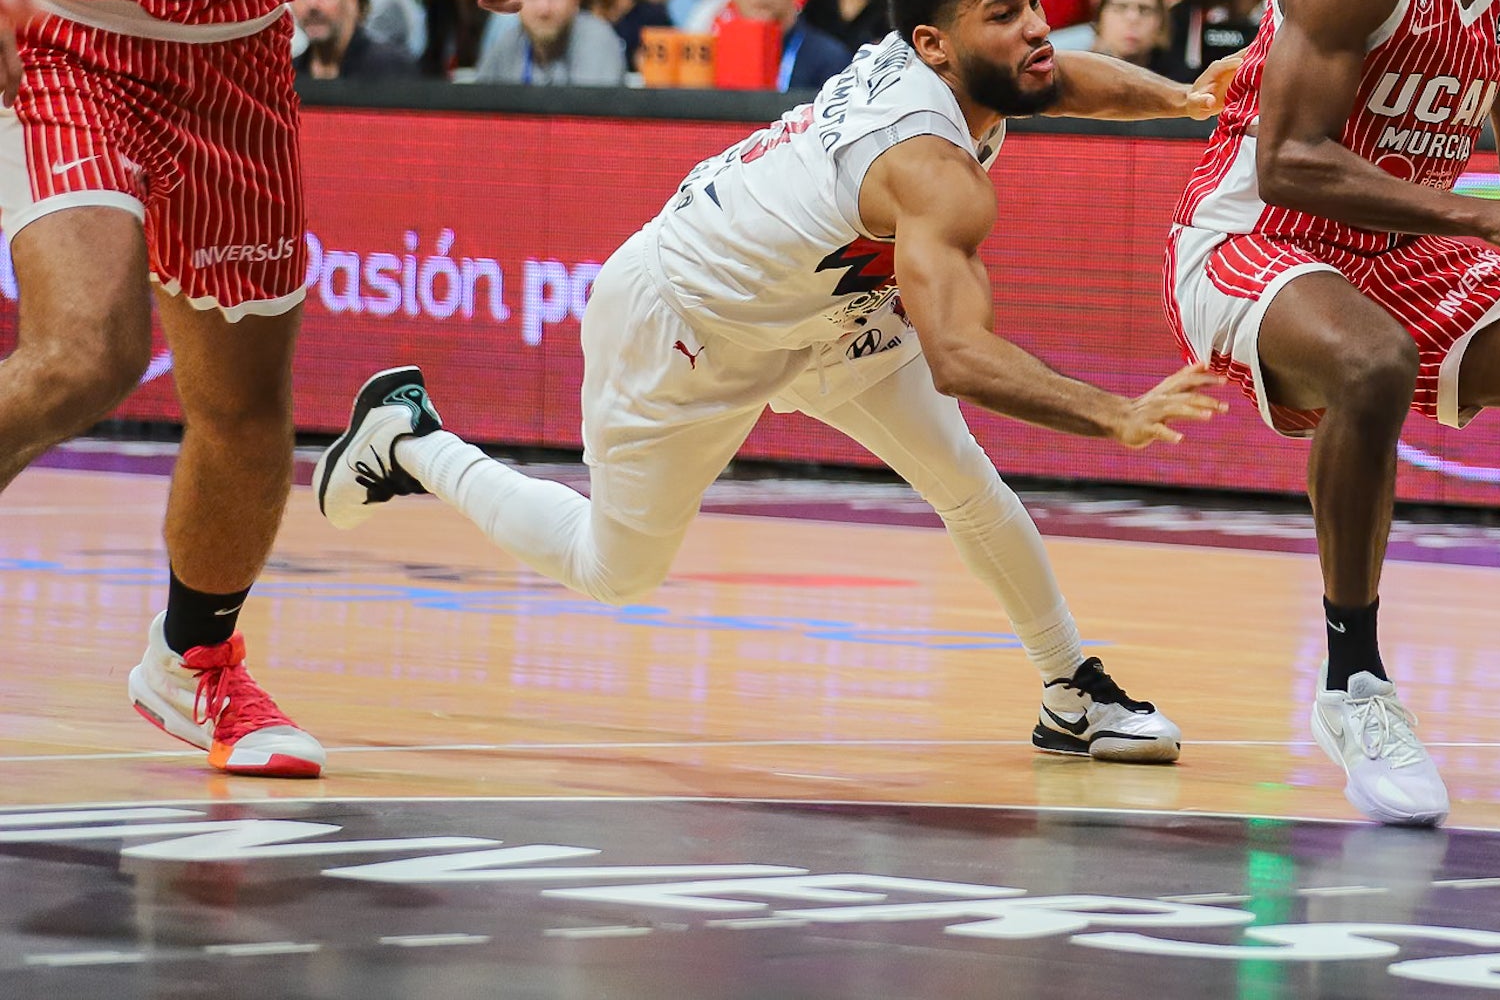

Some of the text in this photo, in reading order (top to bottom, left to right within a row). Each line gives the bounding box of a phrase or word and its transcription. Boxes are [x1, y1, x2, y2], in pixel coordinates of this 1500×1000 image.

[1378, 126, 1472, 161] MURCIA
[194, 236, 298, 270] INVERSUS
[522, 256, 603, 346] po
